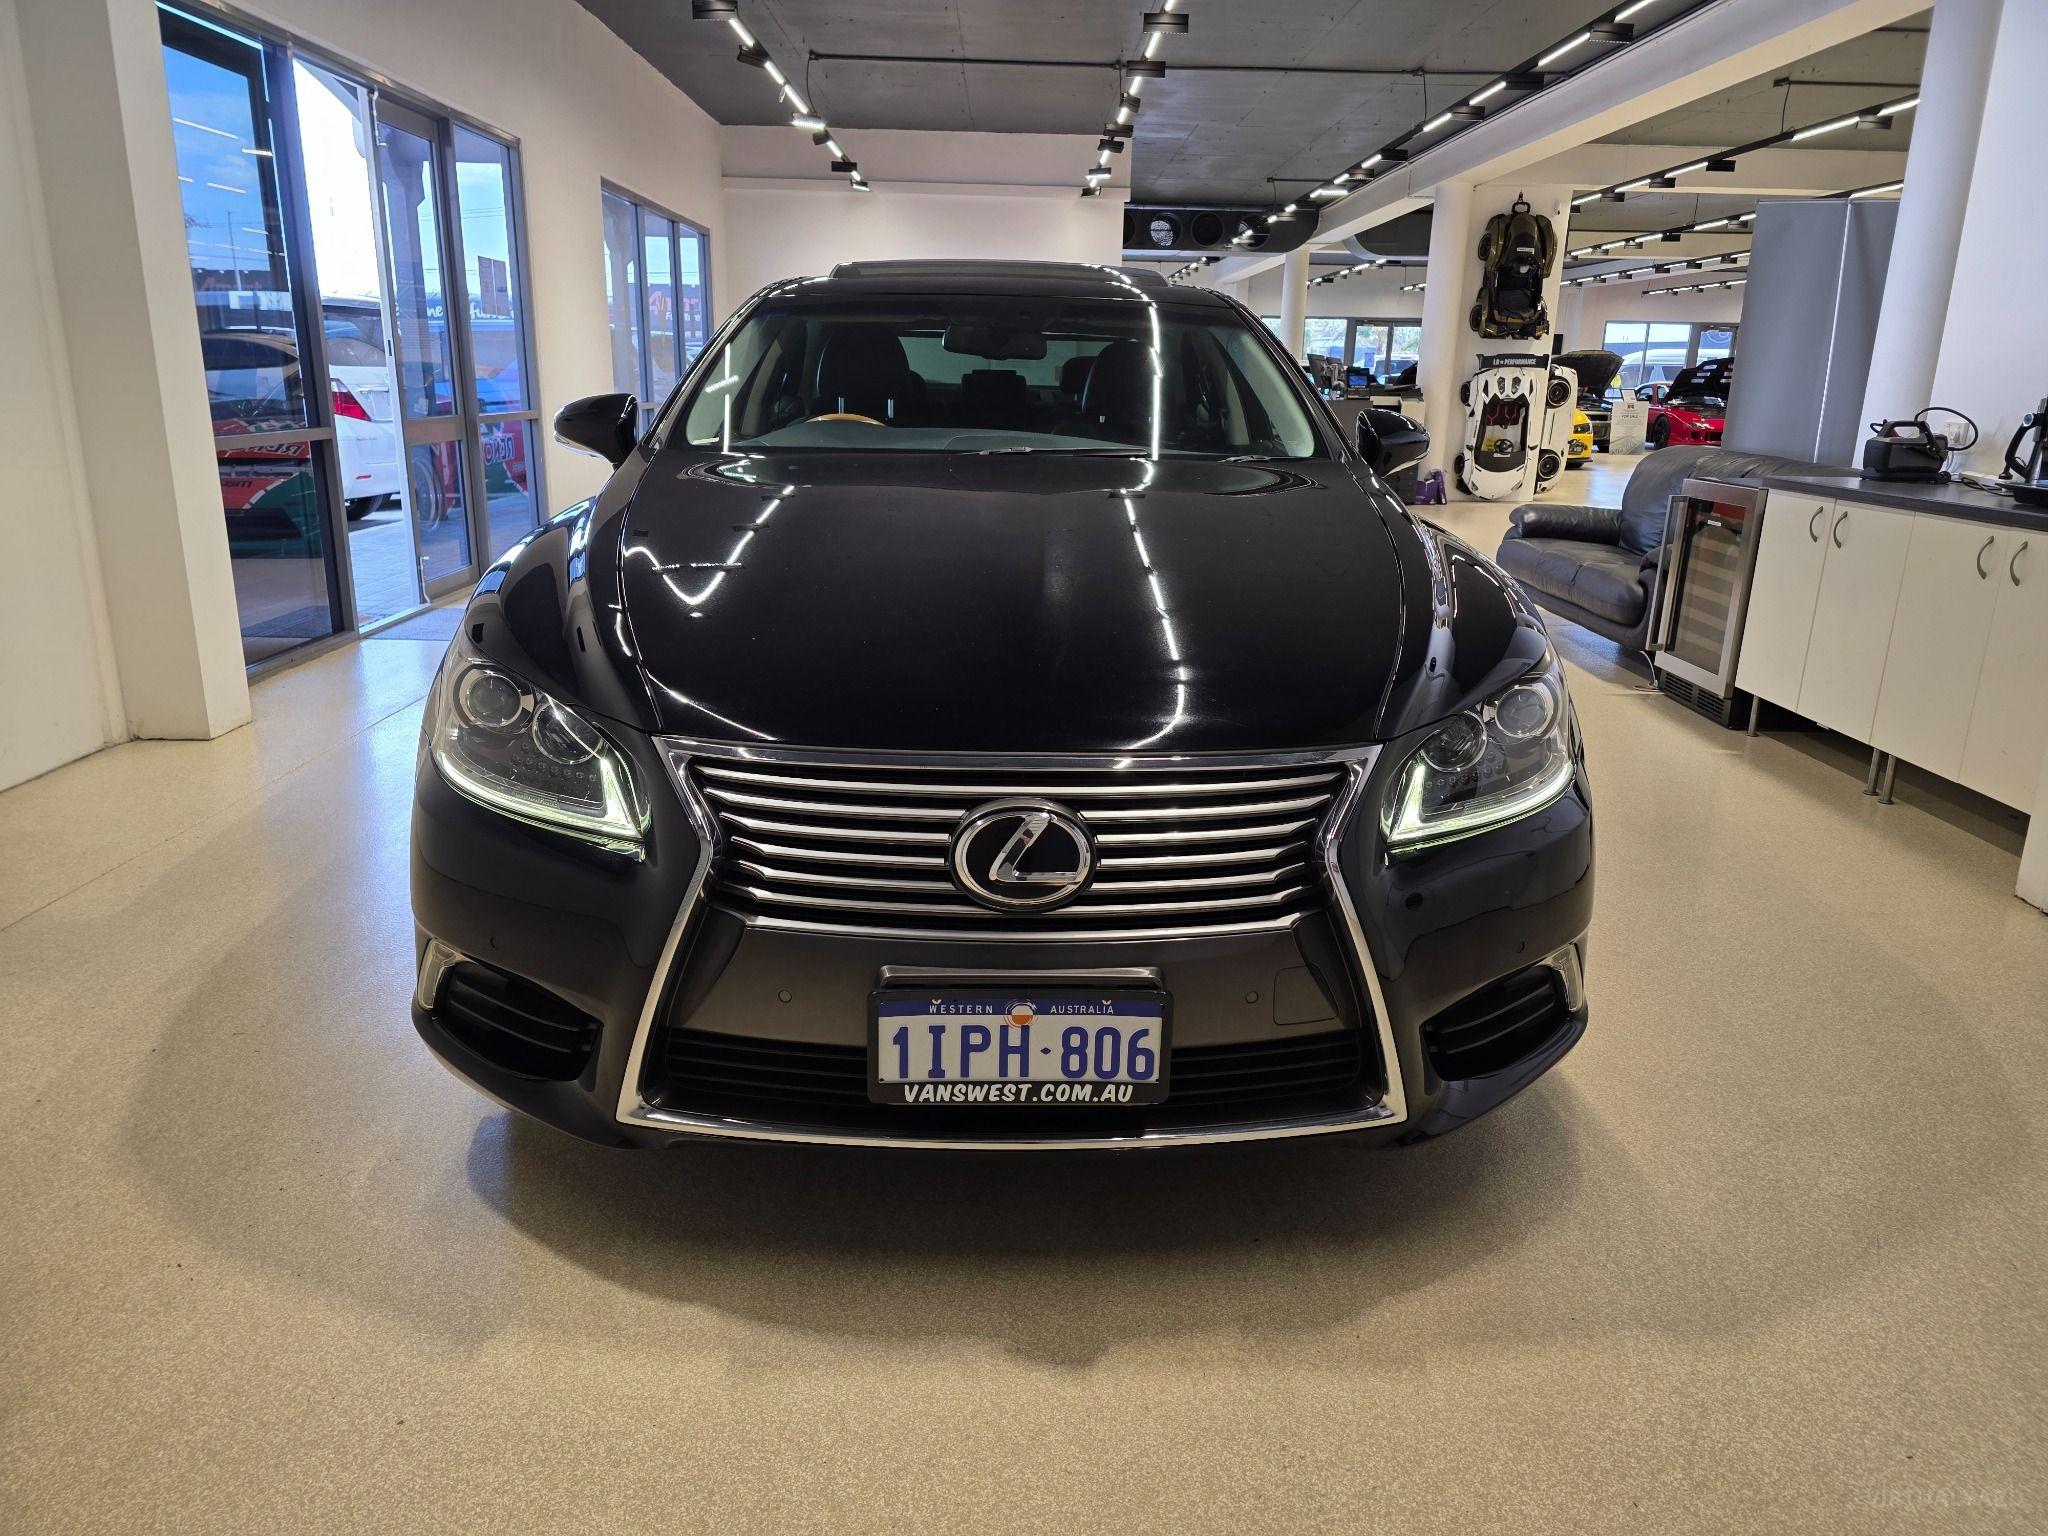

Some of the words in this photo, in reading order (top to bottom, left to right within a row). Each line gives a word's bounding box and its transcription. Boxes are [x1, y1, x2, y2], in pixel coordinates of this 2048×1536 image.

[929, 1004, 993, 1015] WESTERN
[1050, 1004, 1114, 1015] AUSTRALIA
[904, 1084, 1134, 1103] VANSWEST.COM.AU
